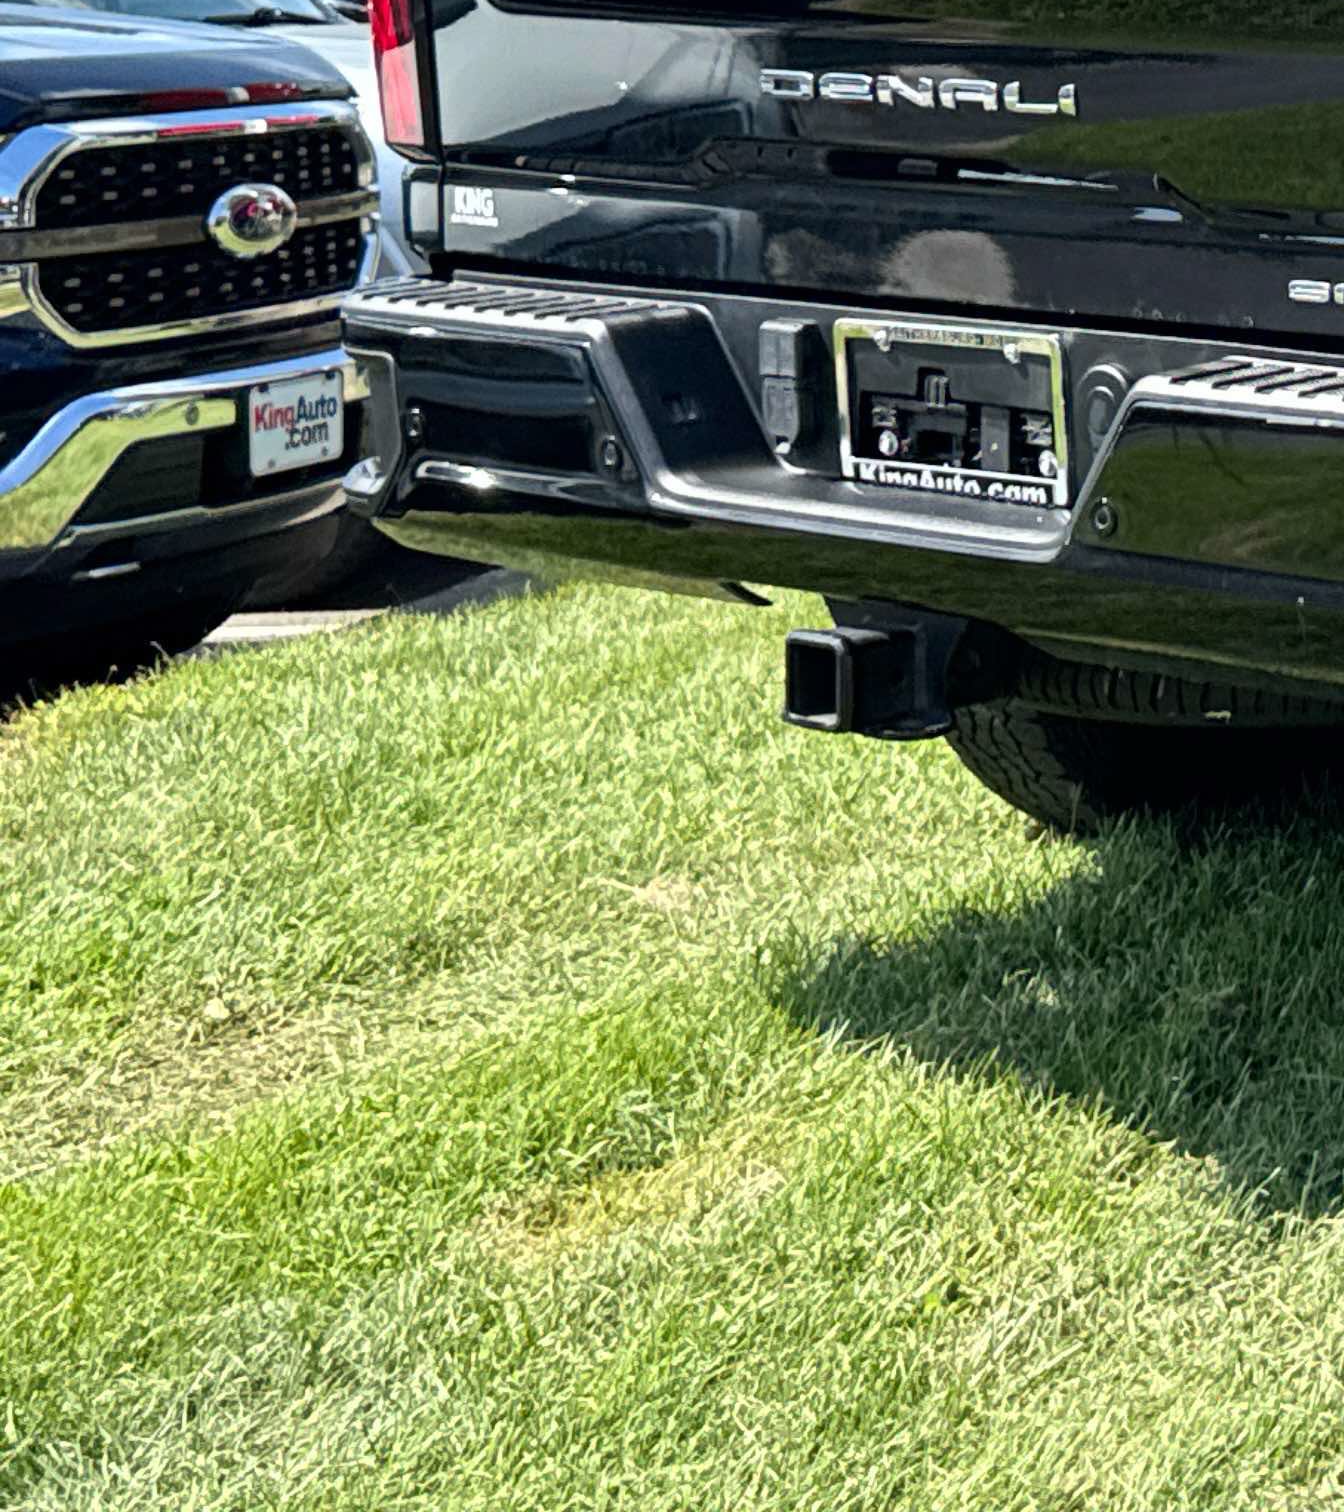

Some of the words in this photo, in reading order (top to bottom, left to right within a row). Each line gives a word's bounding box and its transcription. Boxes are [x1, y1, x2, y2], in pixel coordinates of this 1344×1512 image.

[760, 68, 1076, 116] DENALI
[454, 186, 495, 217] KING
[254, 394, 337, 432] KingAuto
[285, 422, 329, 450] .com
